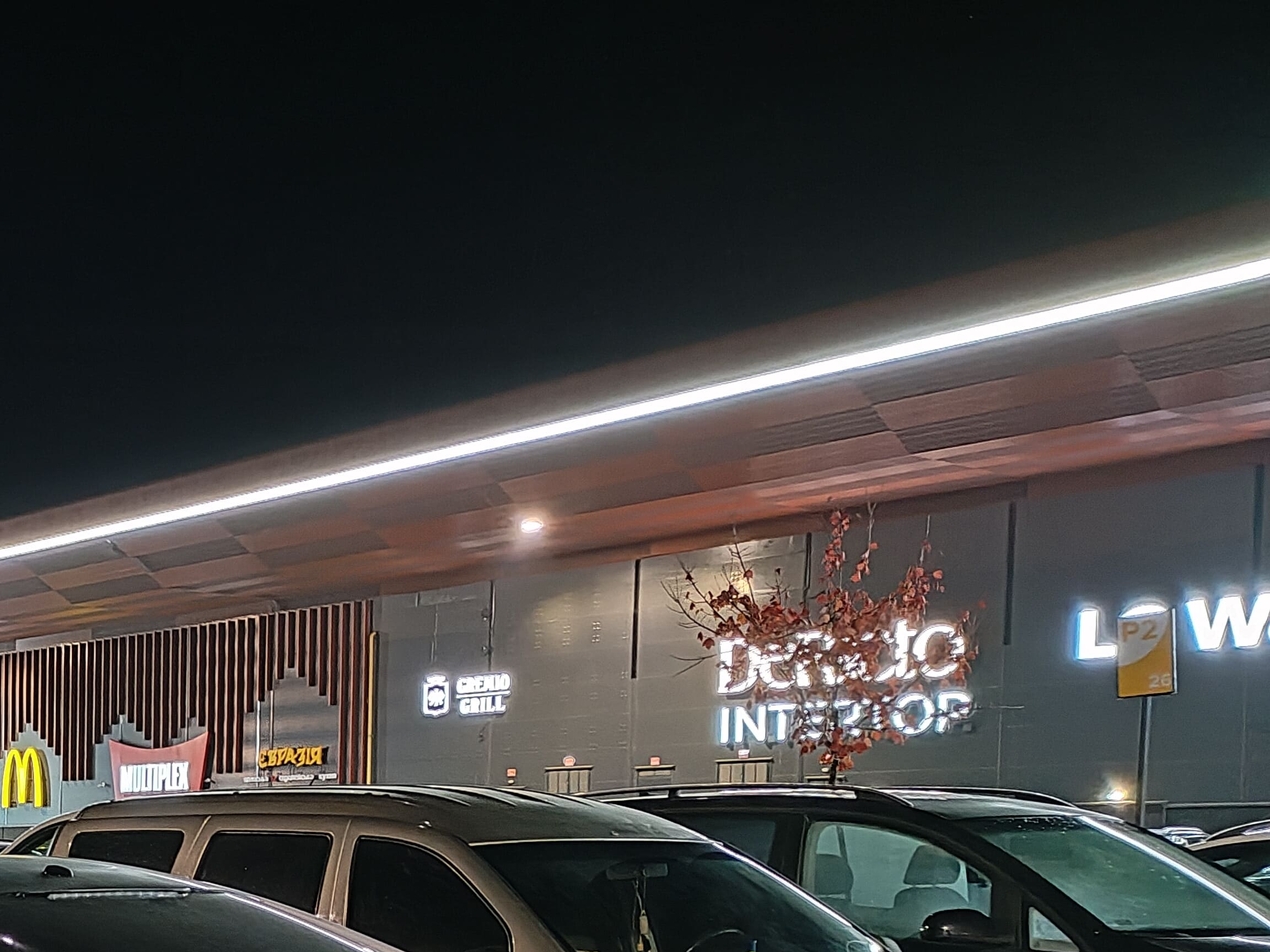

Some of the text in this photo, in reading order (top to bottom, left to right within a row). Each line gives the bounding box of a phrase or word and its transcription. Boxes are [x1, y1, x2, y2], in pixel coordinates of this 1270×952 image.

[1122, 620, 1158, 642] P2
[1148, 674, 1171, 688] 26
[459, 695, 507, 715] GRILL
[120, 762, 190, 793] MULTIPLEX
